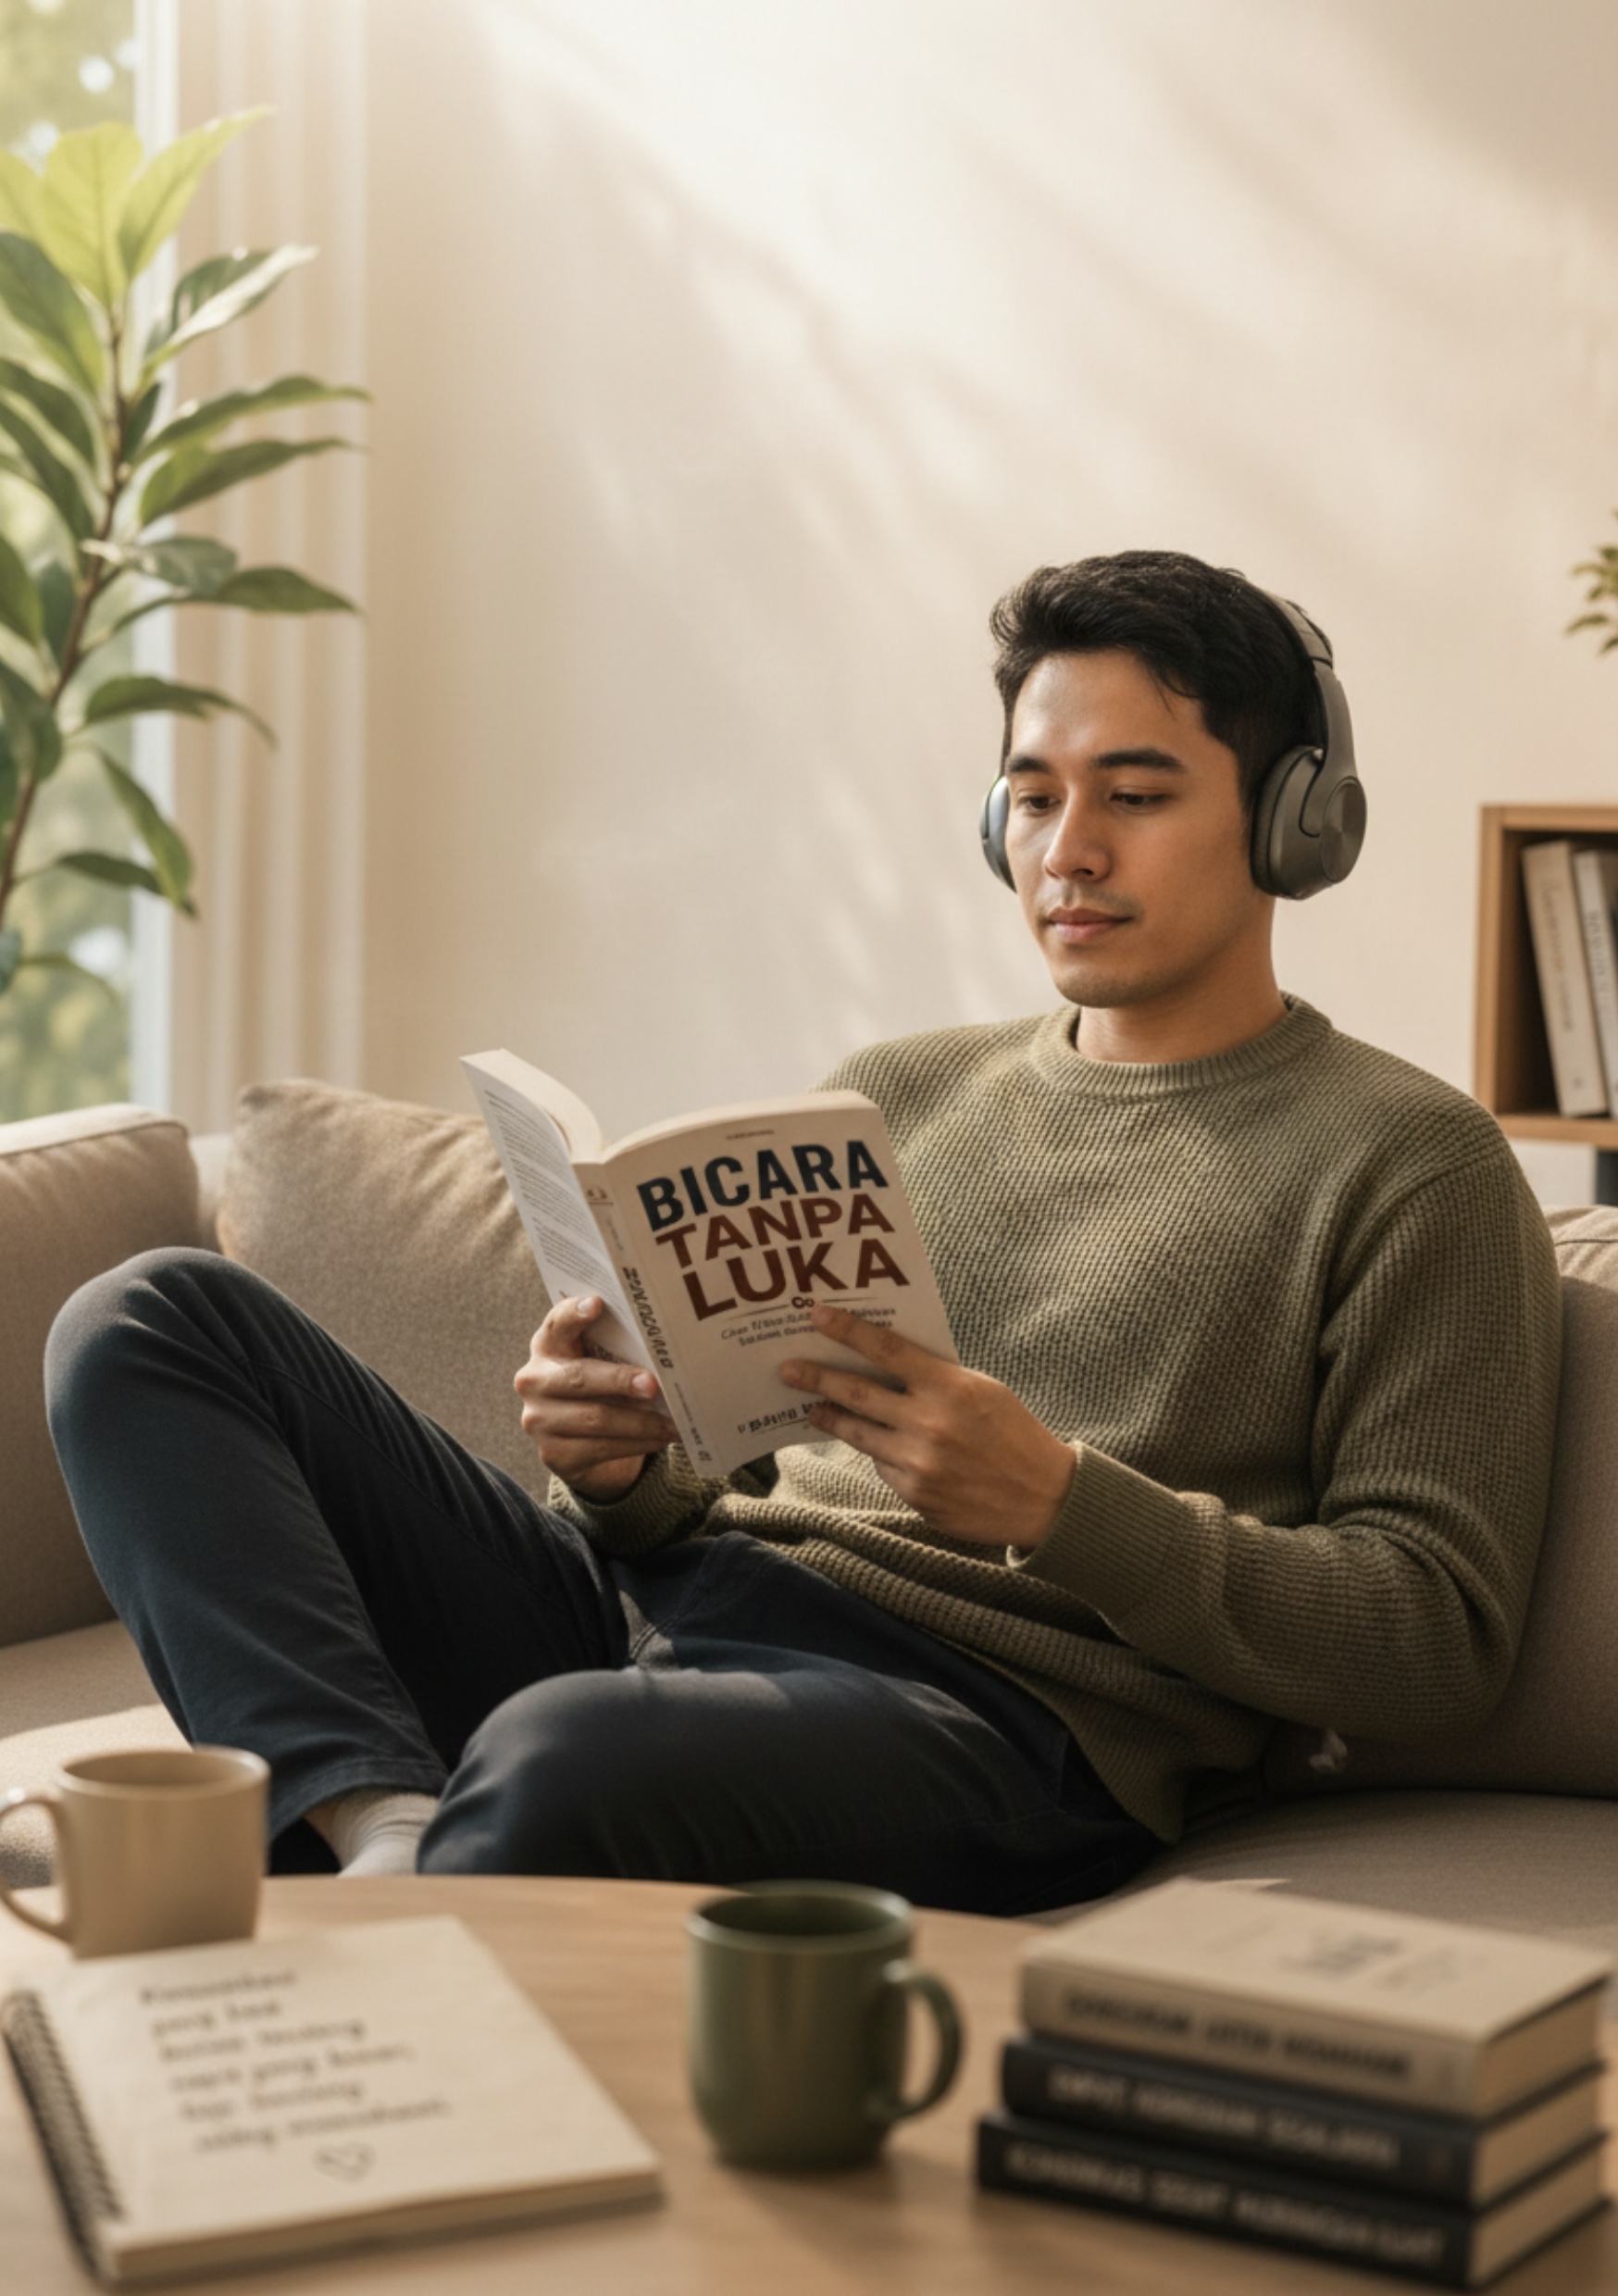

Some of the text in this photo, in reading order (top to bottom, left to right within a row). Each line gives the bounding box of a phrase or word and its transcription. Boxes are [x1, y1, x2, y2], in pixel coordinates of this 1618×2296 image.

[636, 1140, 890, 1232] BICARA
[654, 1193, 896, 1269] TANPA
[682, 1238, 911, 1322] LUKA
